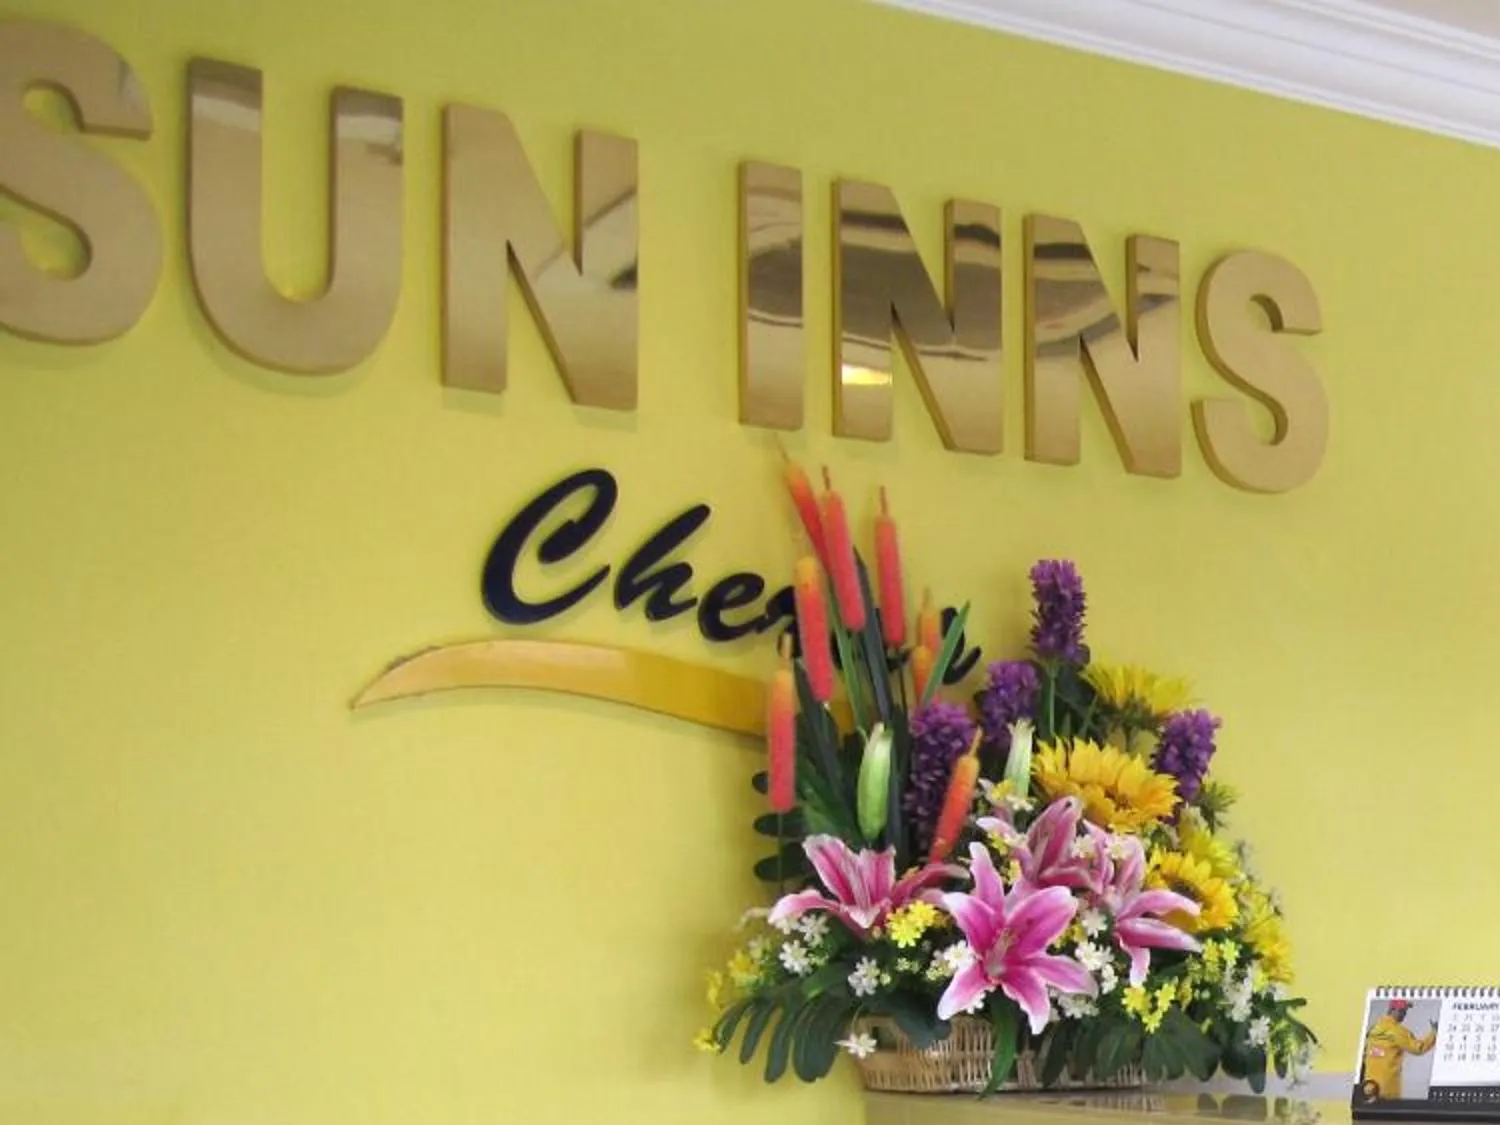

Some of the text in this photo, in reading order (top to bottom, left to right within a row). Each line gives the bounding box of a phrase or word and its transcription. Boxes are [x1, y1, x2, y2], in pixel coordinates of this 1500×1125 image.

[0, 20, 1330, 494] SUN INNS
[481, 467, 982, 684] Che
